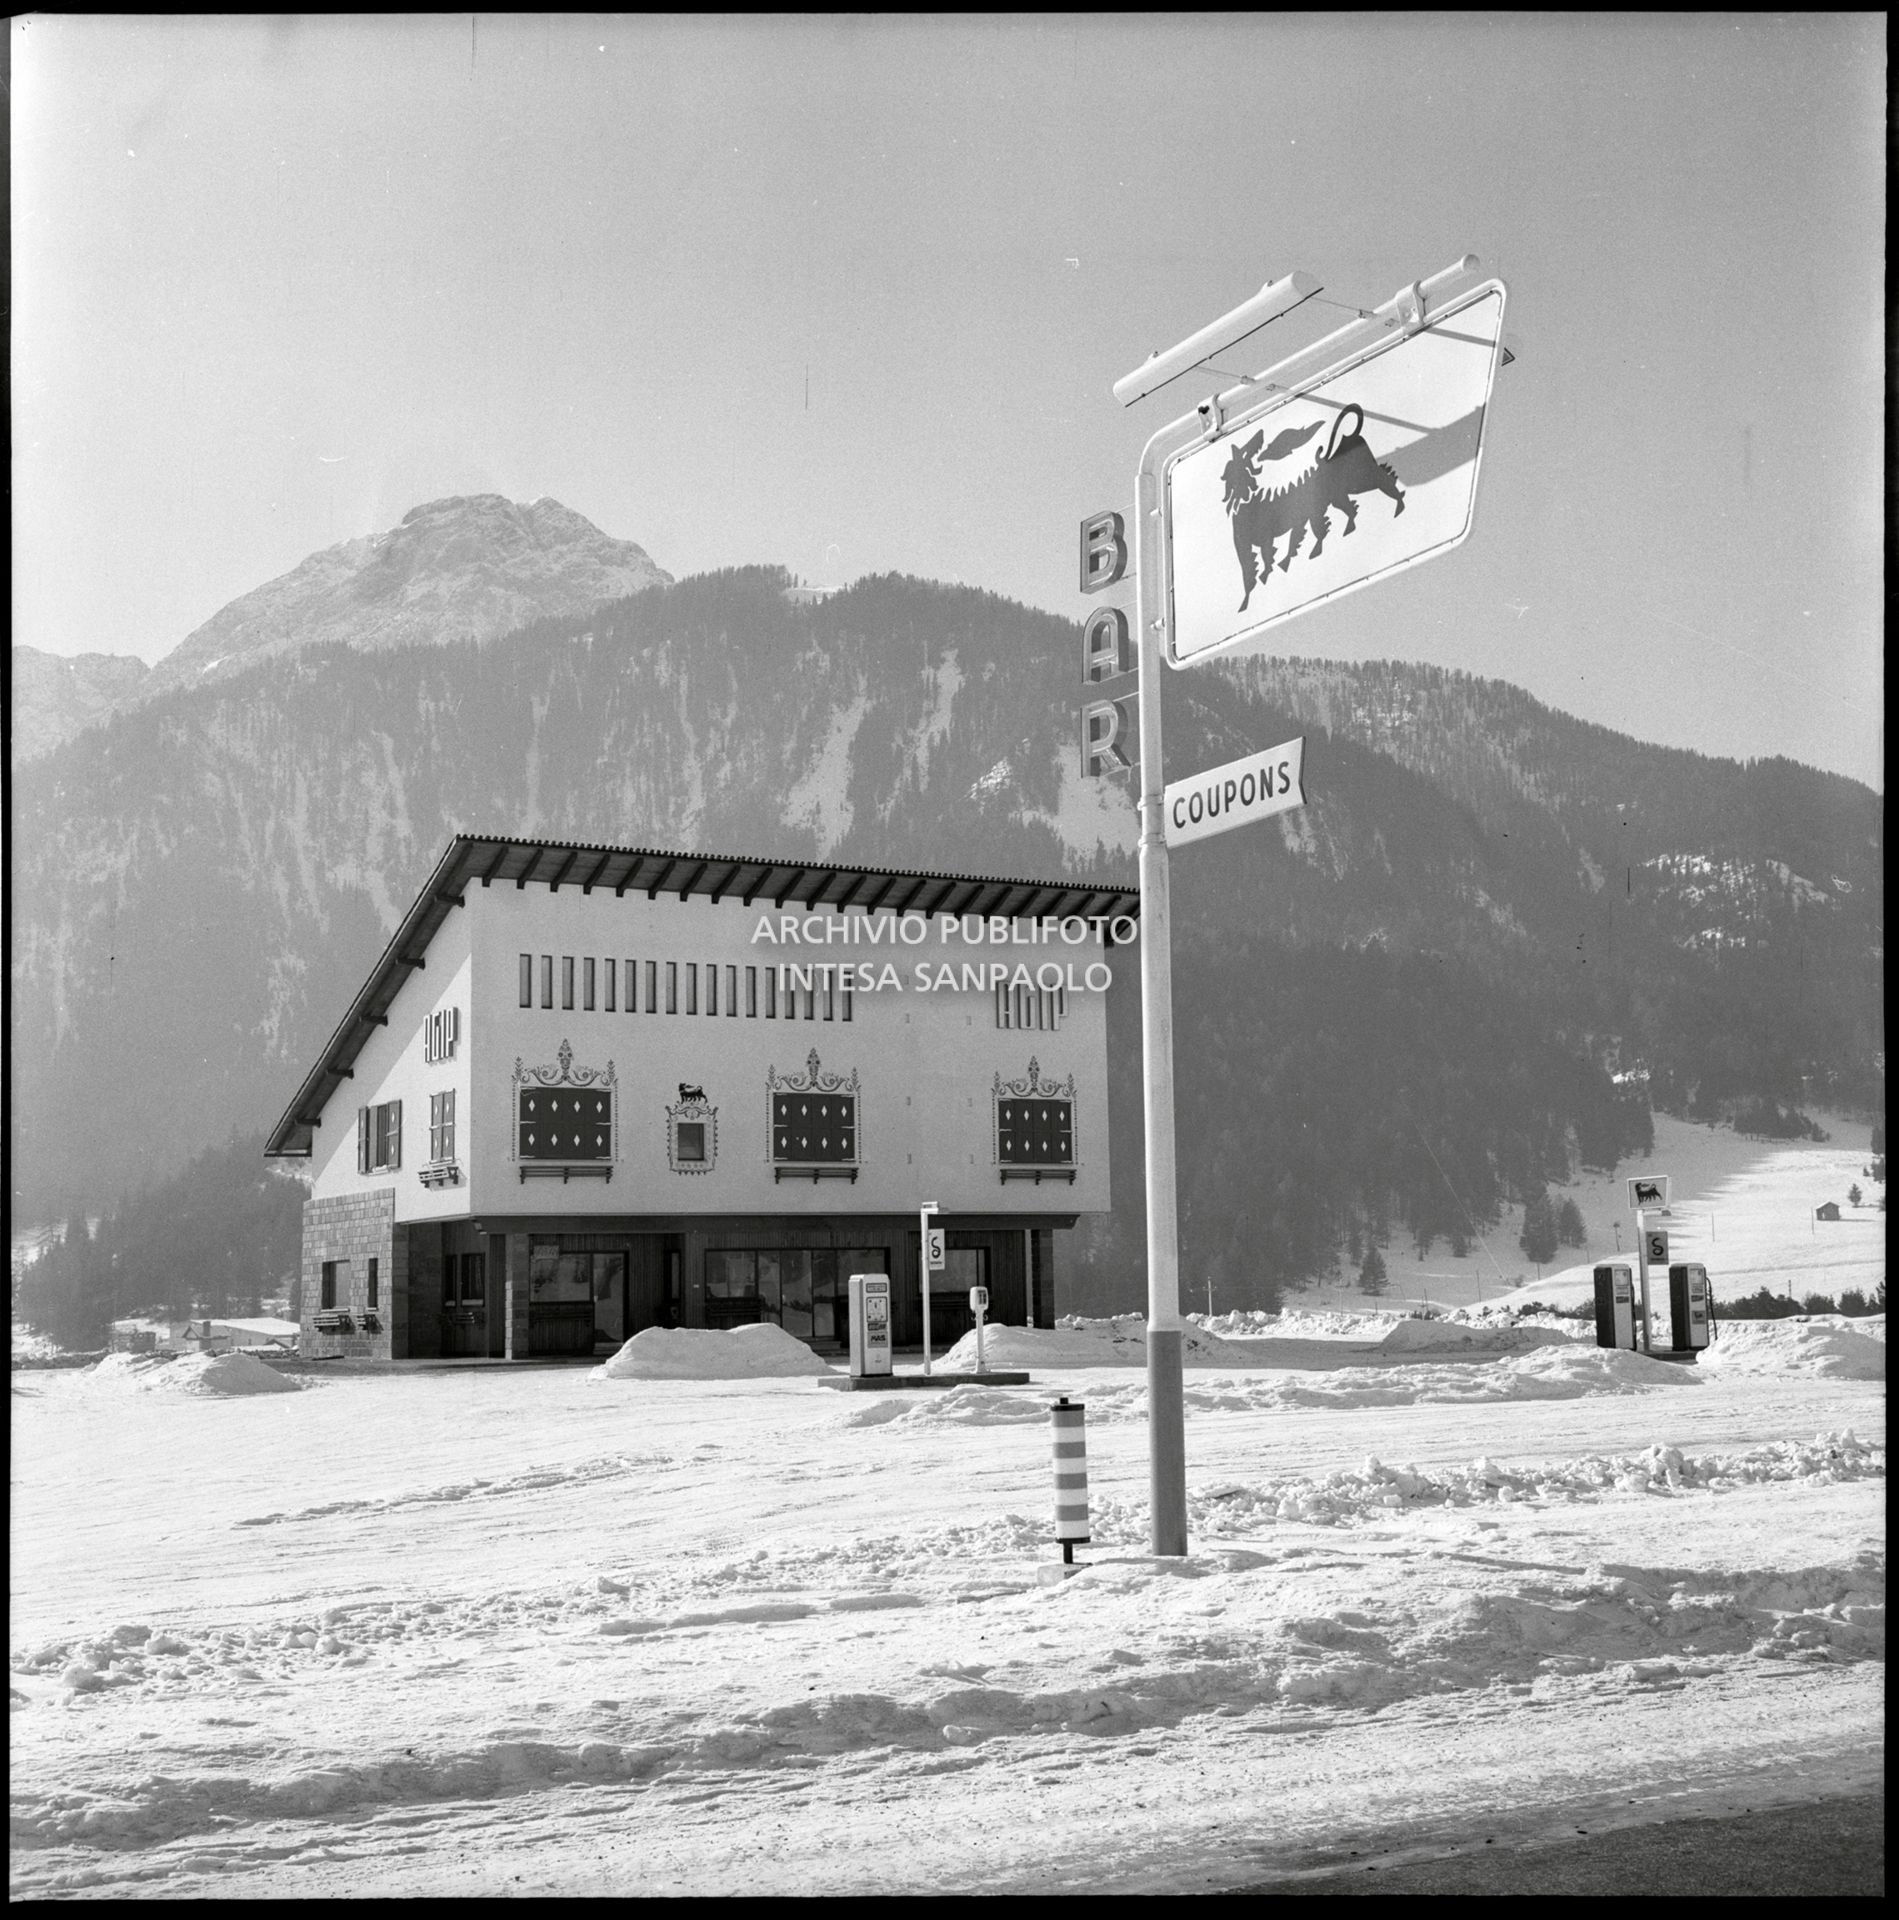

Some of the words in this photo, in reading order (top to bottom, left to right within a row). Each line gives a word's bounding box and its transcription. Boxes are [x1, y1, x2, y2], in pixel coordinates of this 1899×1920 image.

[1080, 510, 1130, 779] BAR
[1172, 761, 1291, 829] COUPONS
[424, 1007, 459, 1063] AGIP
